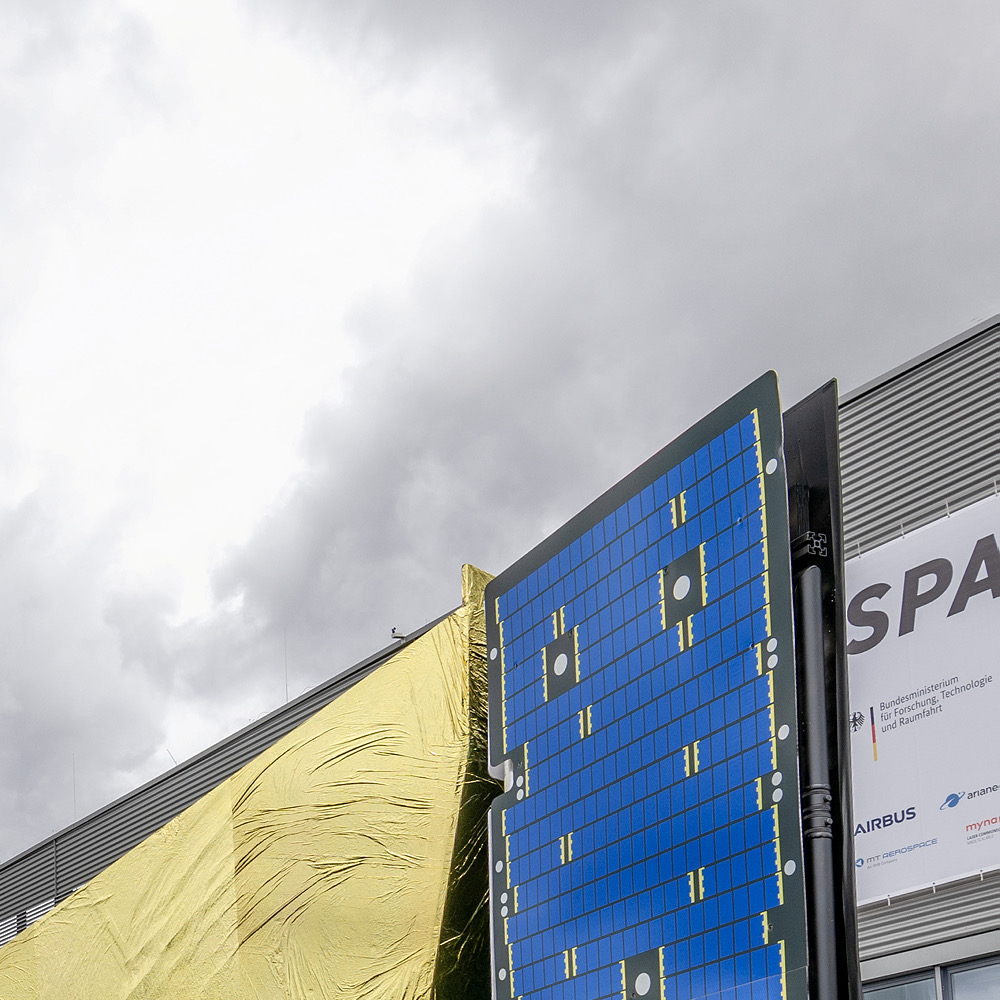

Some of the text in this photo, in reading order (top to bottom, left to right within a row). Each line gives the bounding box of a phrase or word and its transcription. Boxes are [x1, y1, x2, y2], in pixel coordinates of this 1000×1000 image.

[846, 533, 1000, 656] SPA
[879, 676, 959, 711] Bundesministerium
[880, 674, 993, 722] für Forschung, Technologie
[881, 704, 943, 733] und Raumfahrt
[966, 783, 1000, 800] ariane
[854, 806, 917, 837] AIRBUS
[882, 837, 938, 860] AEROSPACE
